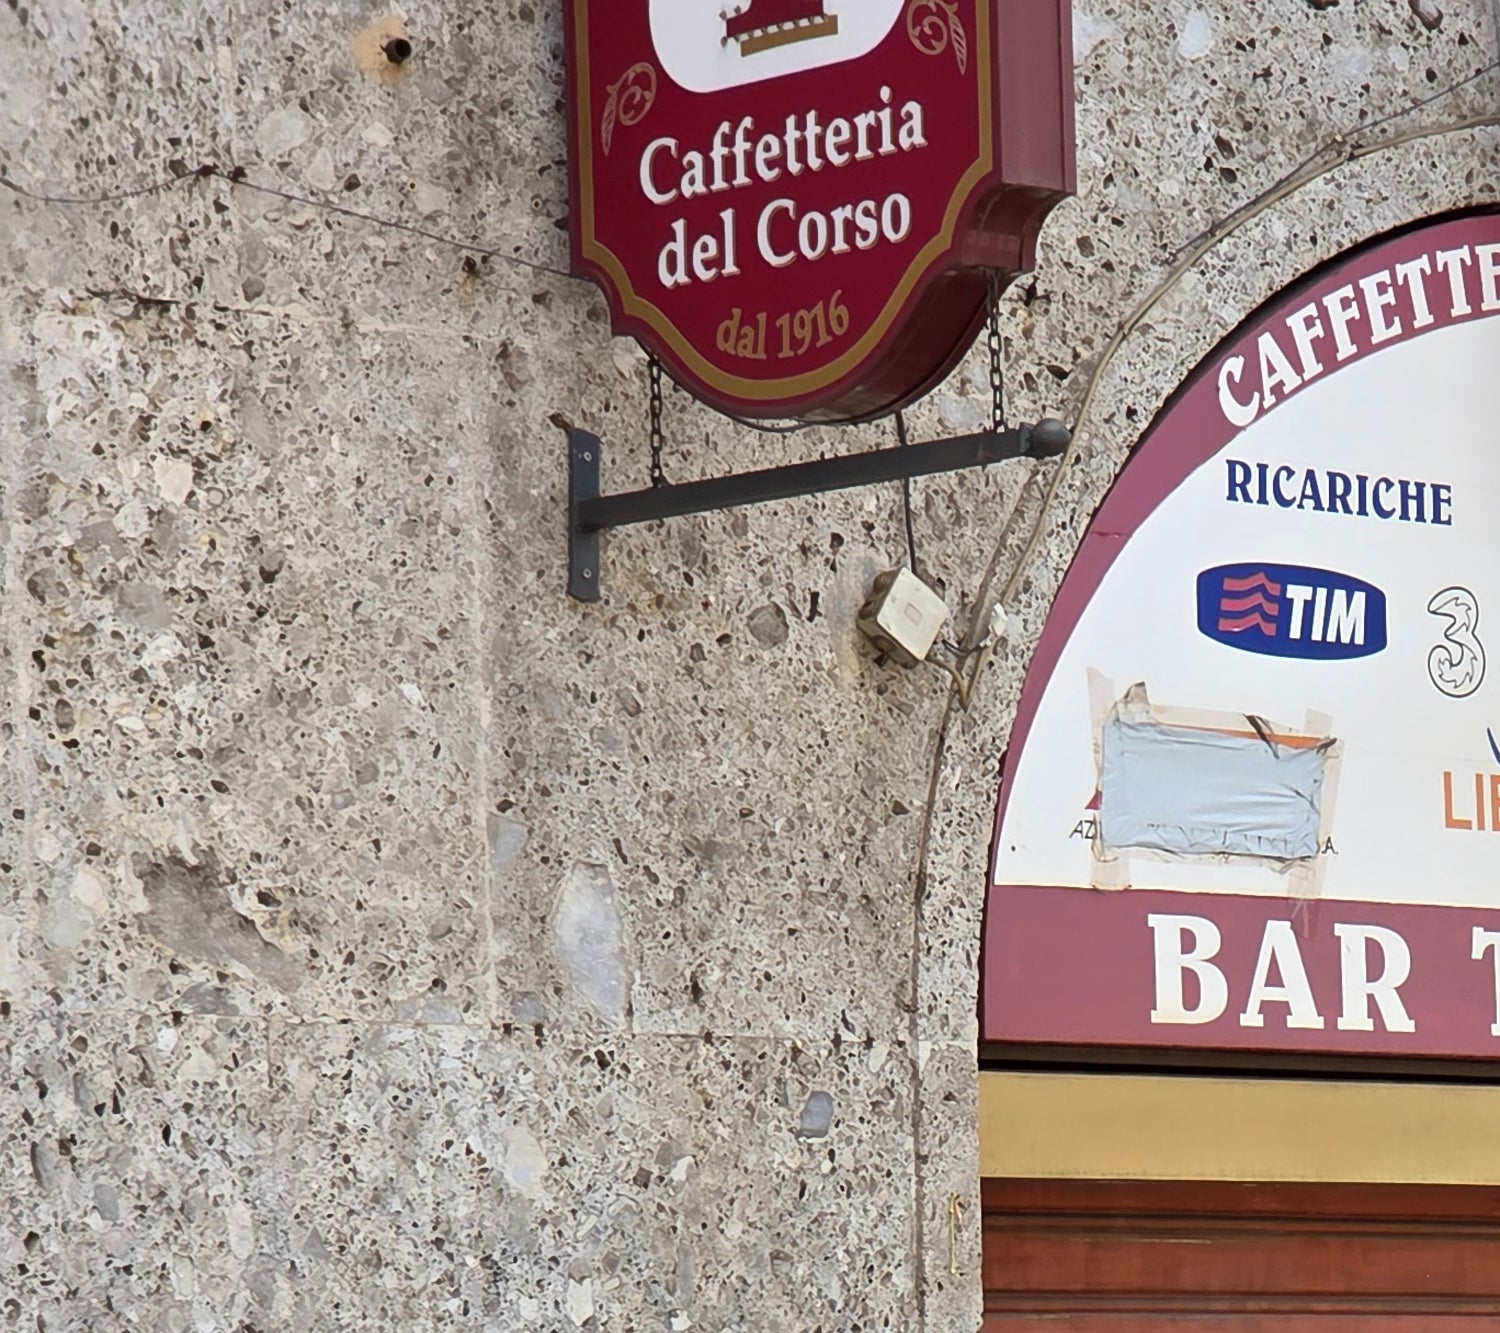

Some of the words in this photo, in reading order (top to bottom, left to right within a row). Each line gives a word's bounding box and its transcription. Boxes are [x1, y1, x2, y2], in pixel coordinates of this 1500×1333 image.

[640, 86, 928, 204] Caffetteria
[658, 208, 740, 289] del
[757, 193, 912, 268] Corso
[716, 308, 767, 360] dal
[776, 289, 850, 358] 1916
[1226, 459, 1453, 526] RICARICHE
[1286, 584, 1366, 646] TIM
[1427, 586, 1486, 697] 3
[1147, 912, 1416, 1033] BAR
